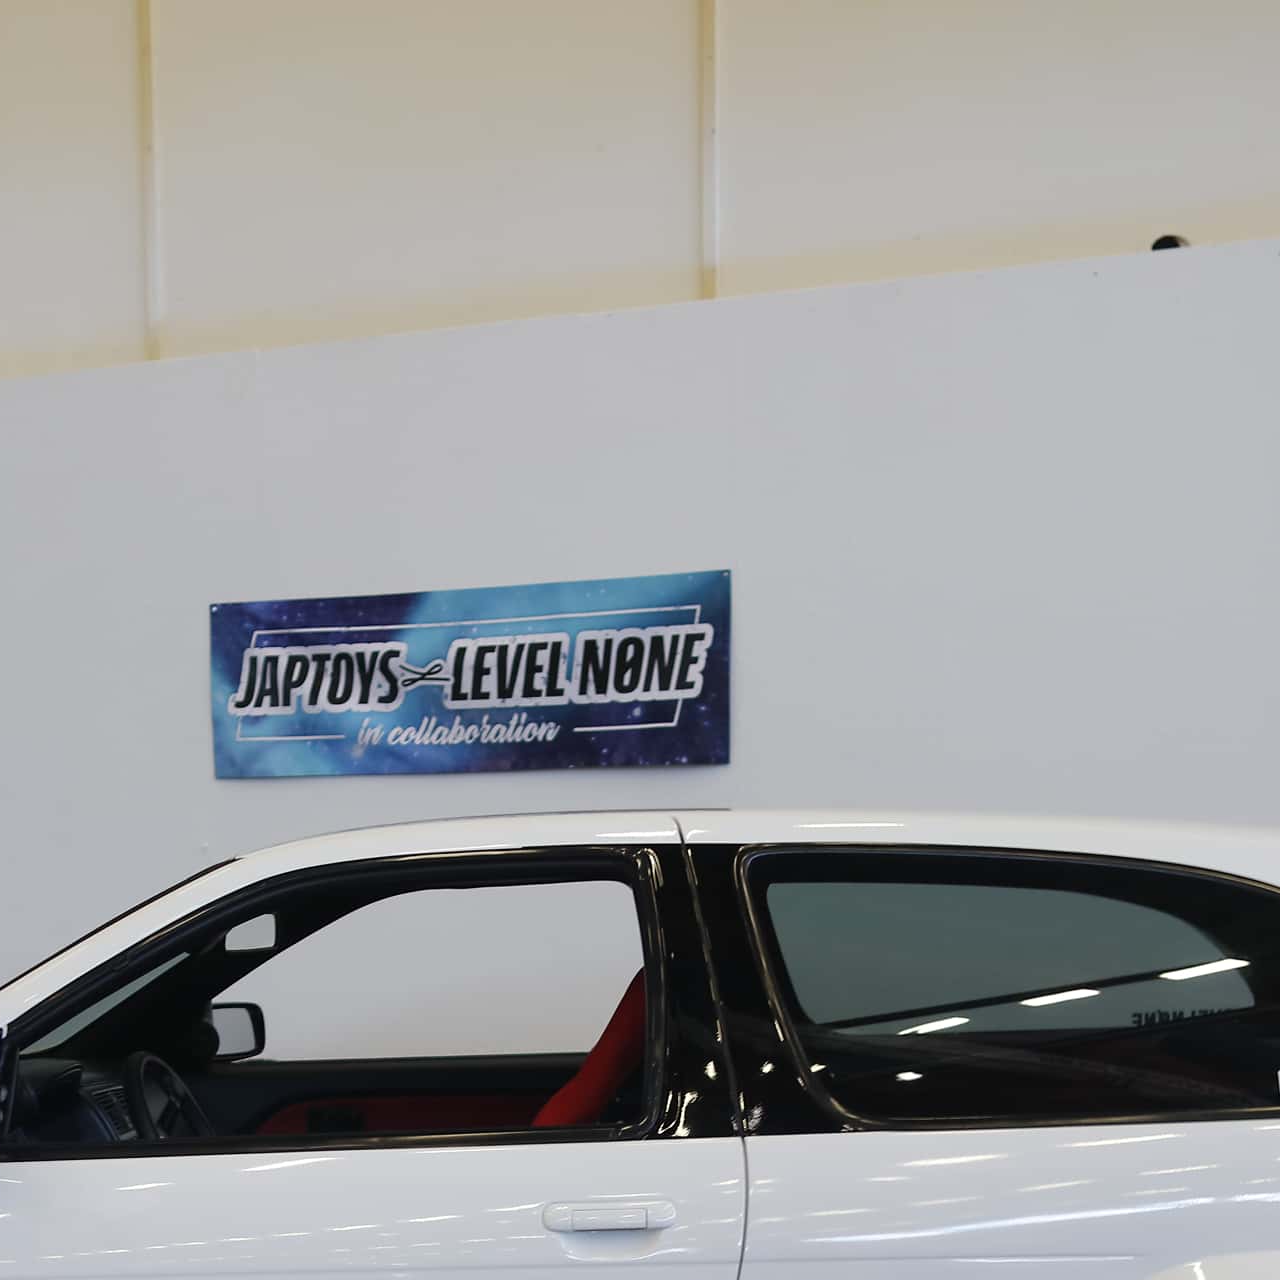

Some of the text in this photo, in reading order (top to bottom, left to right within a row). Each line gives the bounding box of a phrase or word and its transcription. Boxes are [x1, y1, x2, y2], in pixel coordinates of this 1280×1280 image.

[233, 648, 401, 709] JAPTOYS
[452, 638, 566, 702] LEVEL
[352, 711, 561, 758] in collaboration
